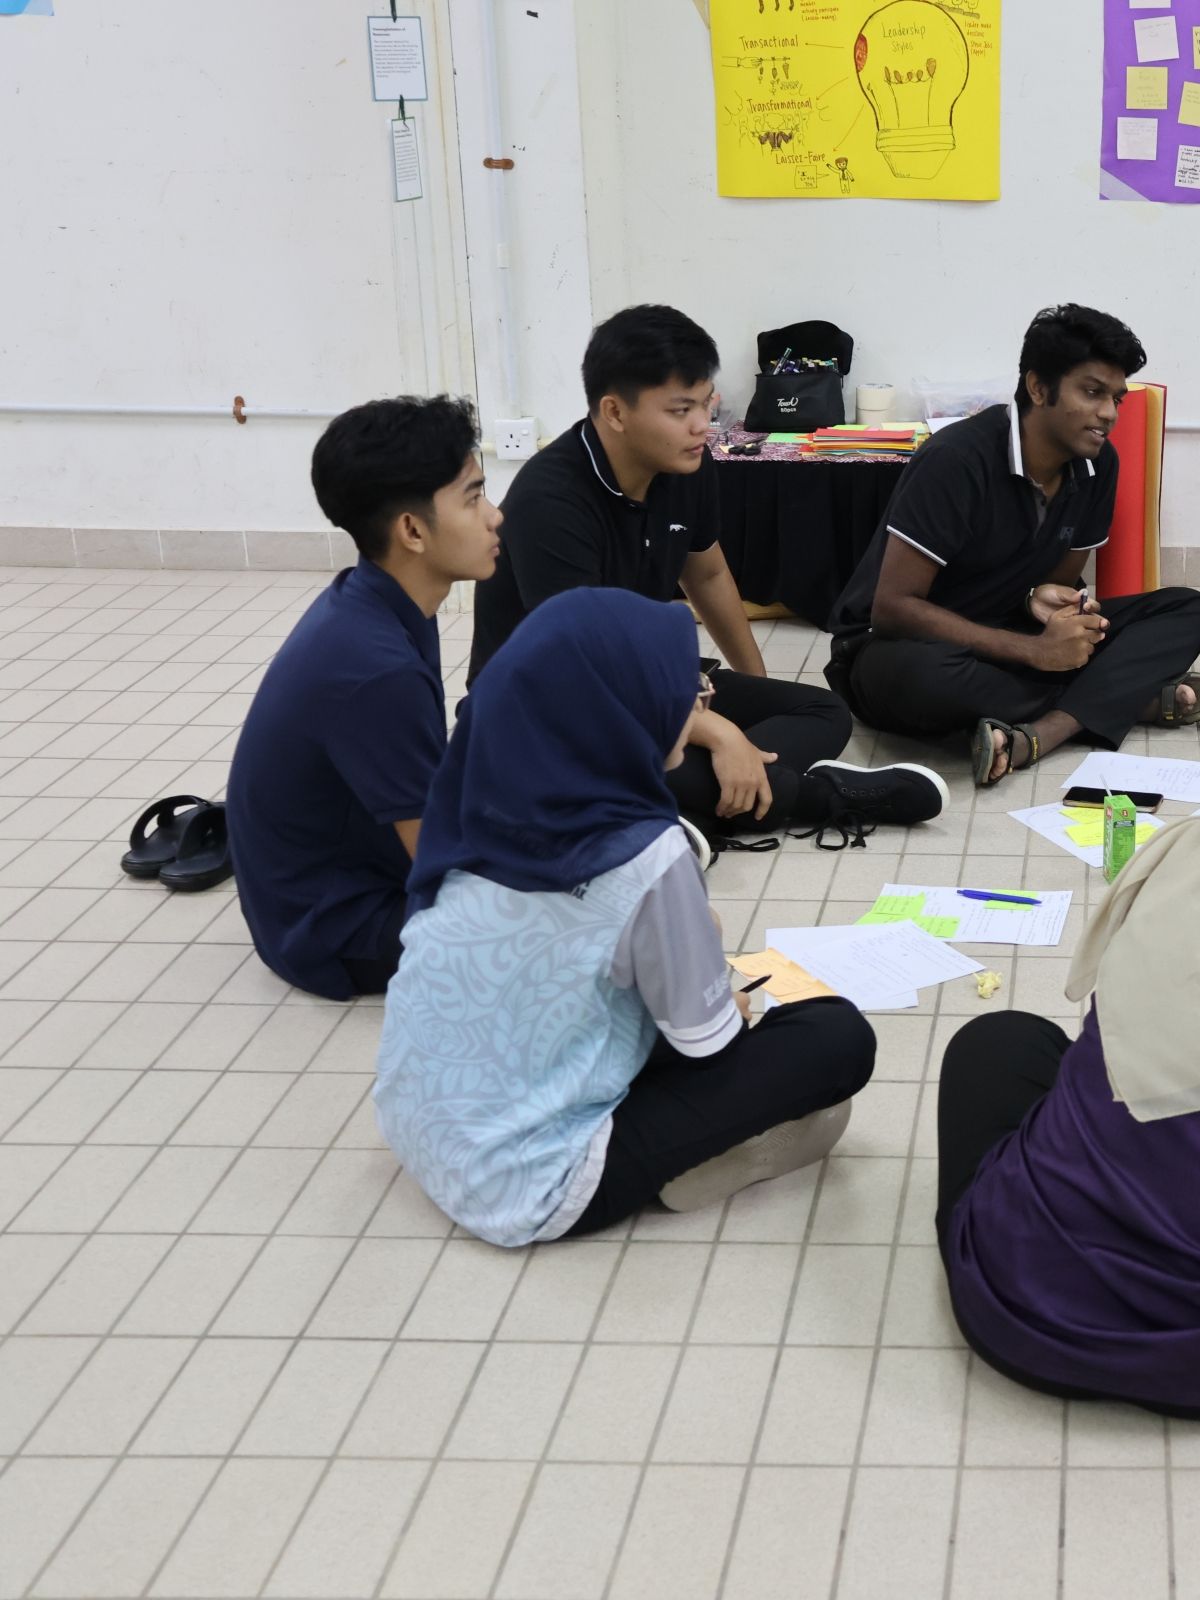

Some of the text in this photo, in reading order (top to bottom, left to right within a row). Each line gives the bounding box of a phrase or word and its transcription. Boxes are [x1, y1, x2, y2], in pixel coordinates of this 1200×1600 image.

[881, 22, 926, 40] Leadership
[738, 34, 800, 51] Transactional
[891, 41, 915, 55] Styles
[746, 97, 813, 114] Transformational
